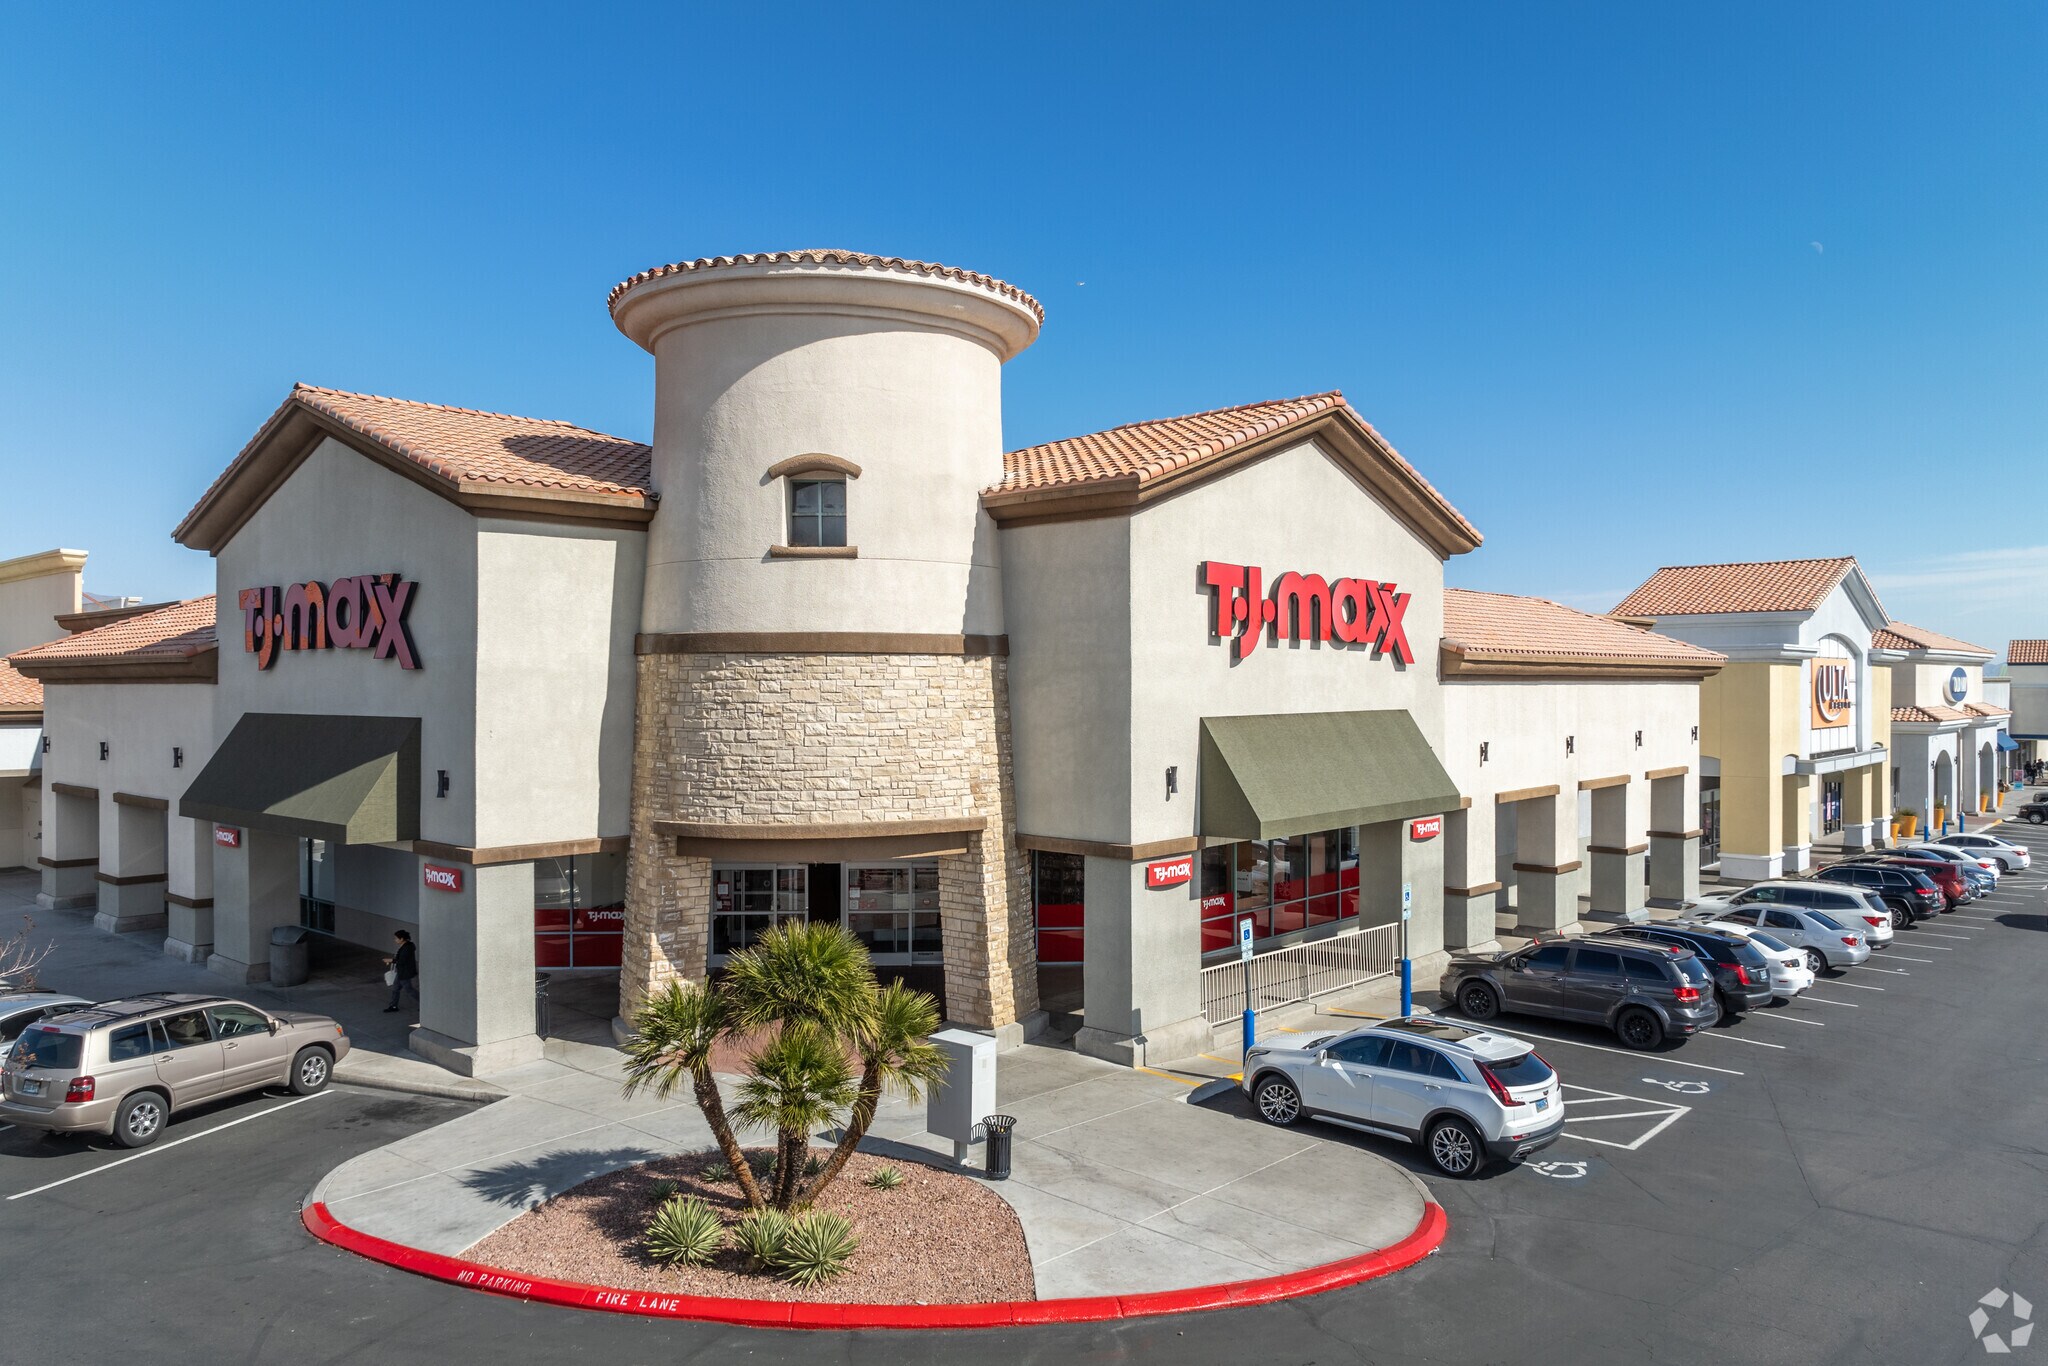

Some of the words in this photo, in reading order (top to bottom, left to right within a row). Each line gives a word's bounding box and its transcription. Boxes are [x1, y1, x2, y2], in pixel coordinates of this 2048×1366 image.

[1820, 665, 1849, 704] ULTA
[457, 1269, 474, 1282] NO
[477, 1273, 532, 1294] PARKING
[595, 1292, 631, 1306] FIRE
[639, 1296, 680, 1311] LANE
